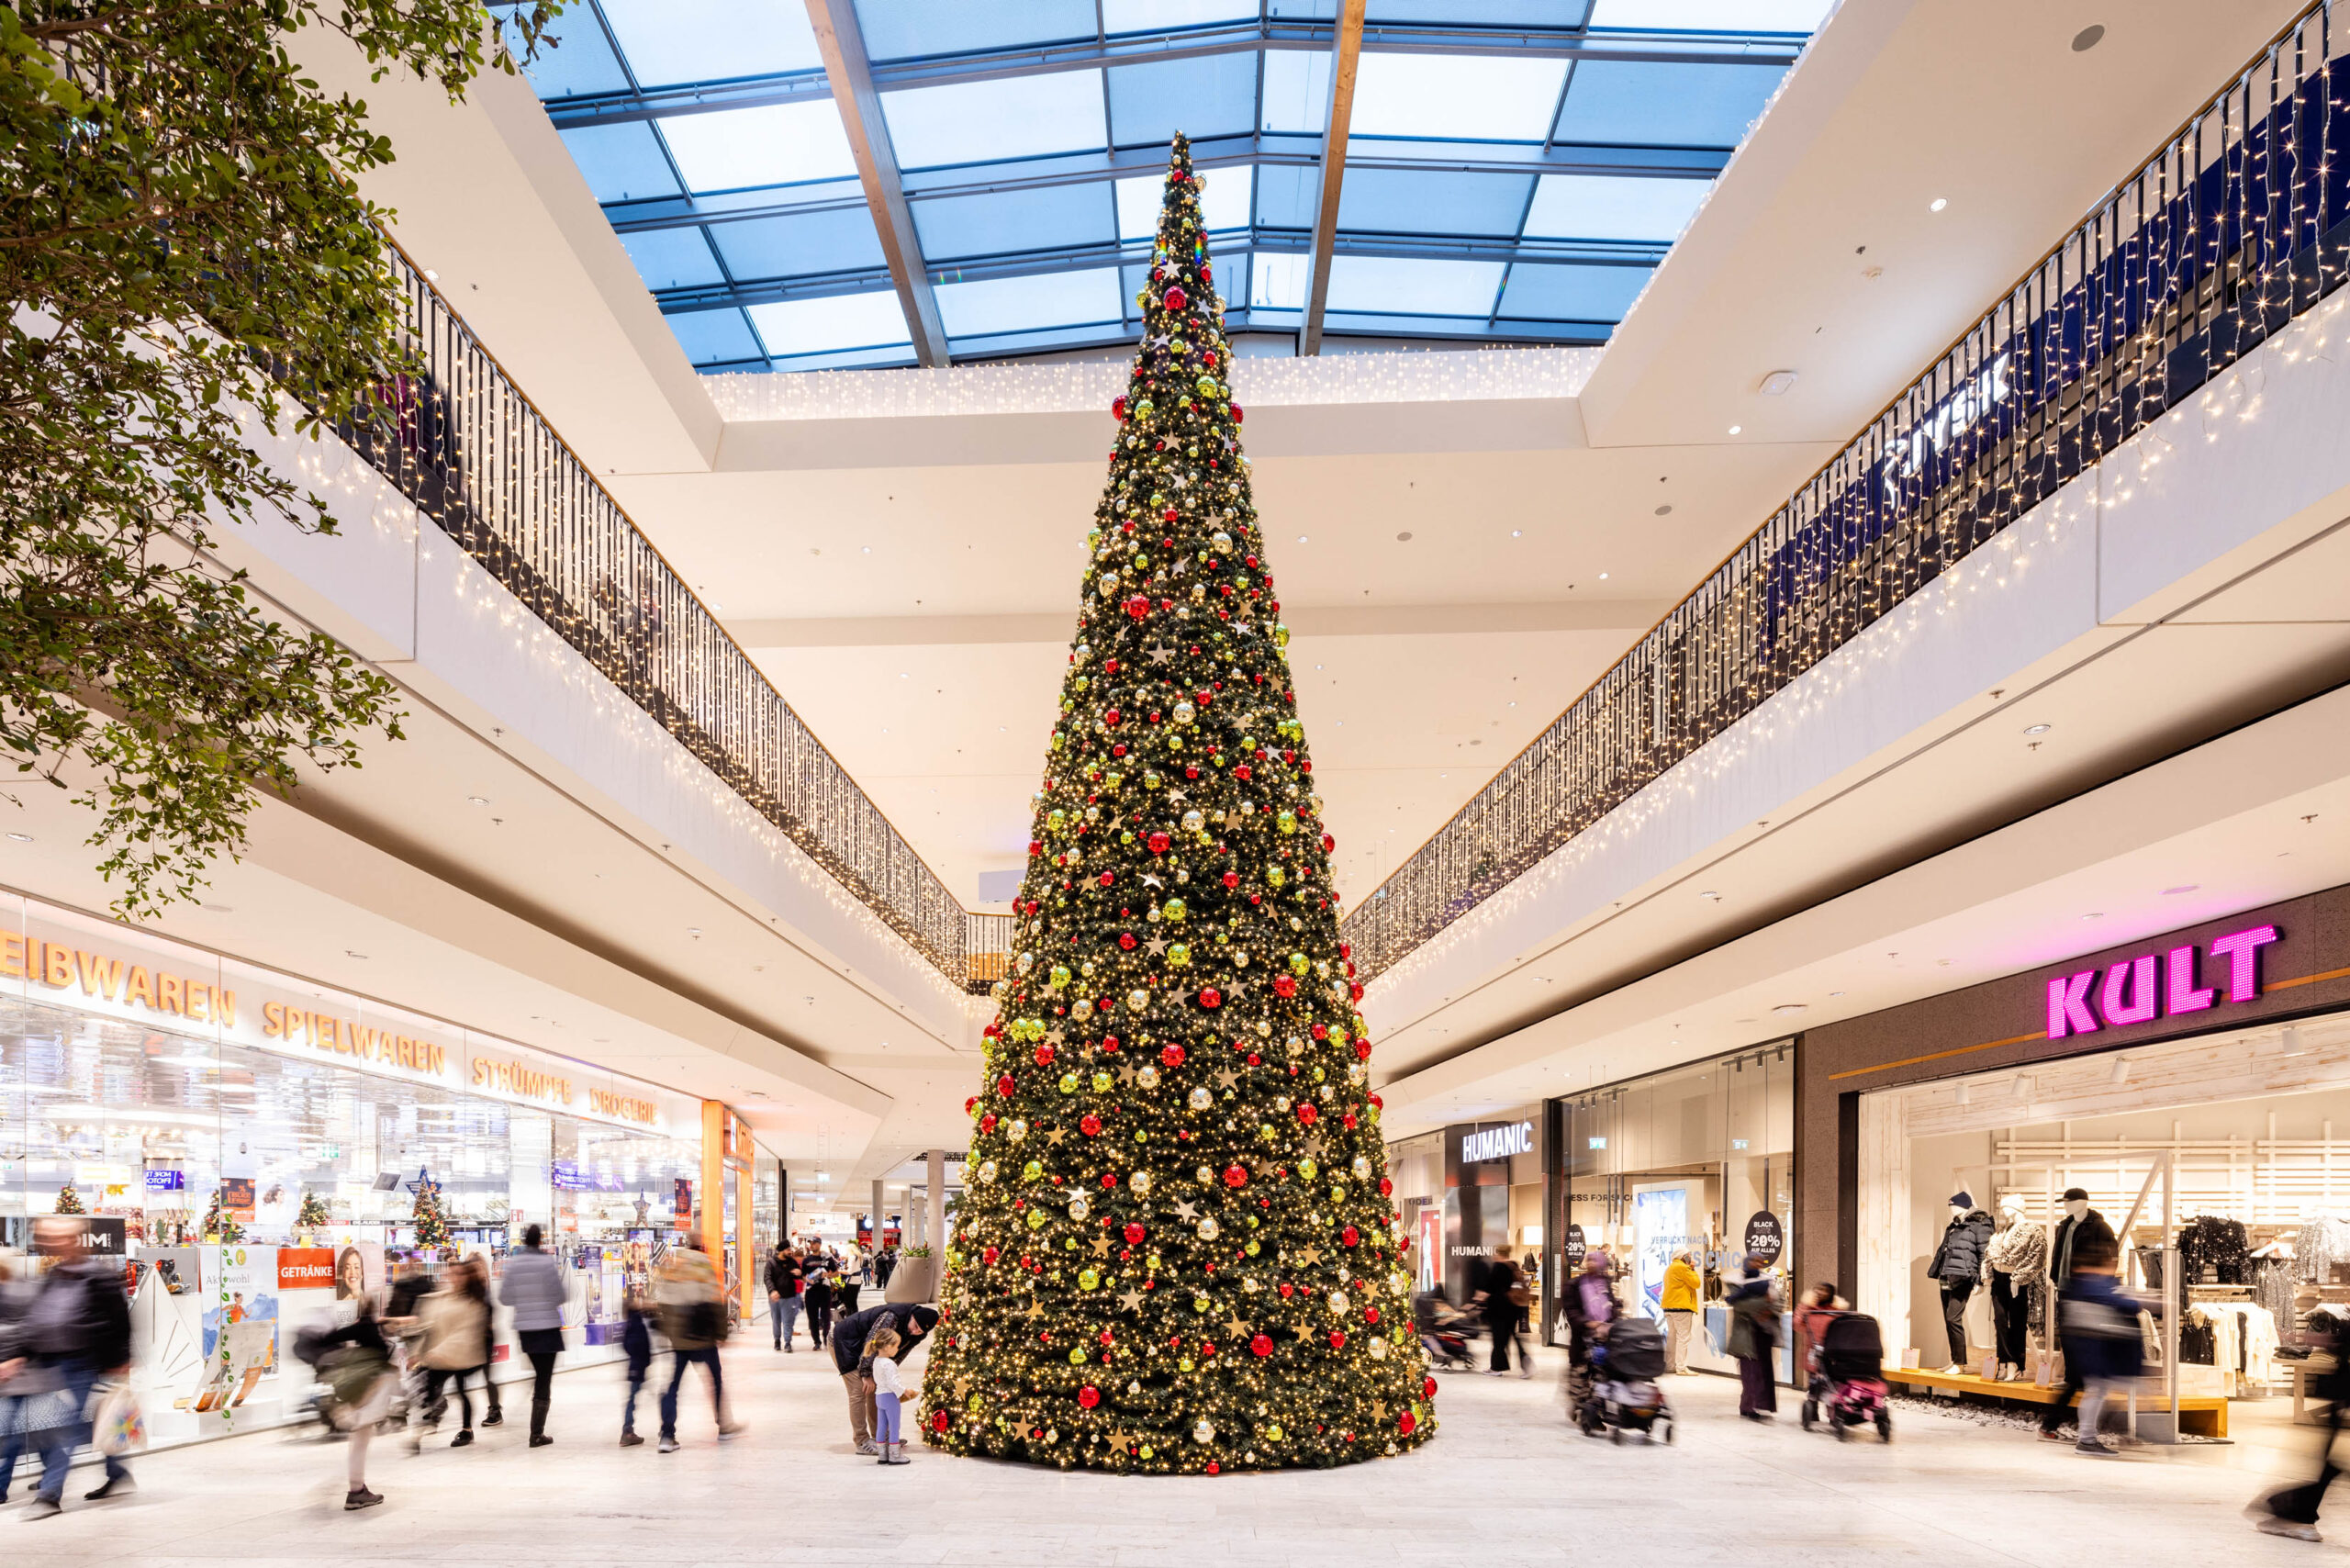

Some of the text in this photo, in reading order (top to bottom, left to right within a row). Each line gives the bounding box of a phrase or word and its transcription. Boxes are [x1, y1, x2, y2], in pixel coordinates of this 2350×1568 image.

[2046, 924, 2284, 1040] KULT
[0, 929, 658, 1126] EIBWAREN SPIELWAREN STRÜMPFE DROGERIE
[1462, 1121, 1534, 1163] HUMANIC
[76, 1233, 107, 1248] IM
[1565, 1241, 1585, 1252] -20%
[1746, 1234, 1781, 1248] -20%
[1705, 1250, 1741, 1269] CHIC
[281, 1264, 333, 1278] GETRÄNKE
